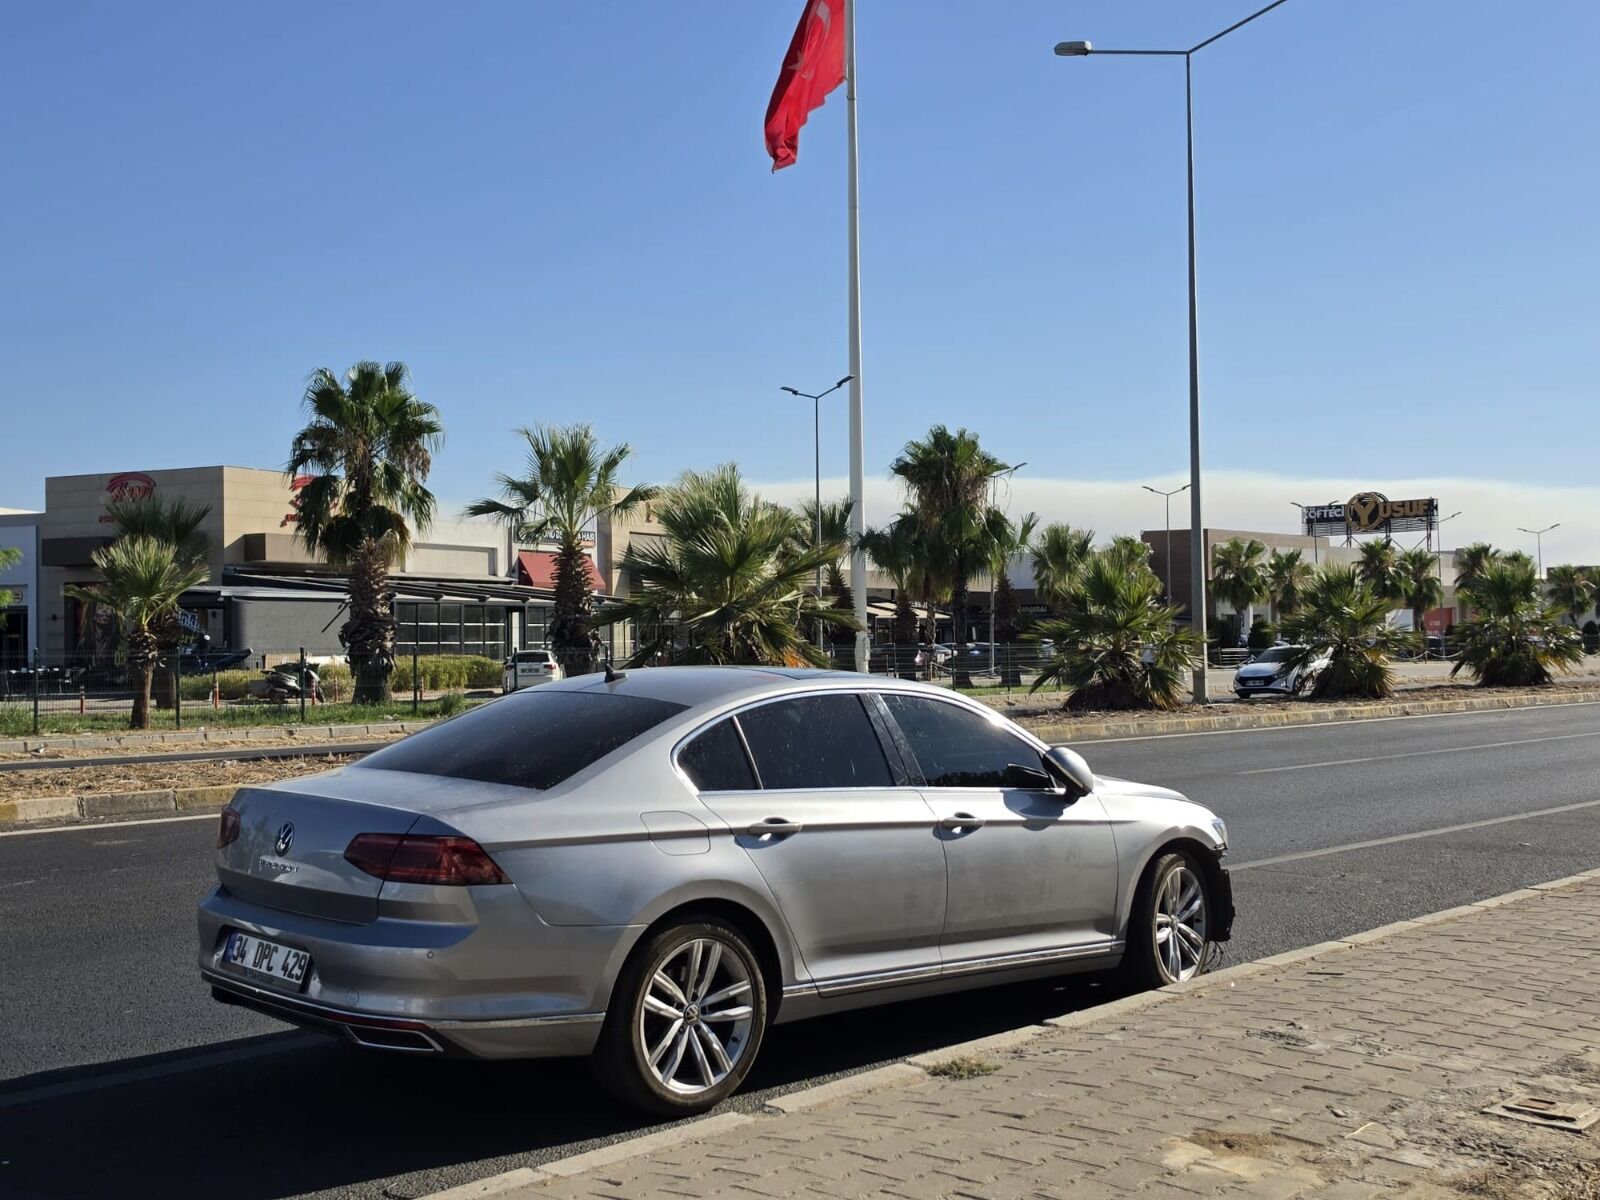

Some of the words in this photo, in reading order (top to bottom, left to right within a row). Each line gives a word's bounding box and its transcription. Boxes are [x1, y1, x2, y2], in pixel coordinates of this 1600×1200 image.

[232, 935, 249, 964] 34
[252, 941, 279, 972] DPC
[281, 949, 308, 981] 429
